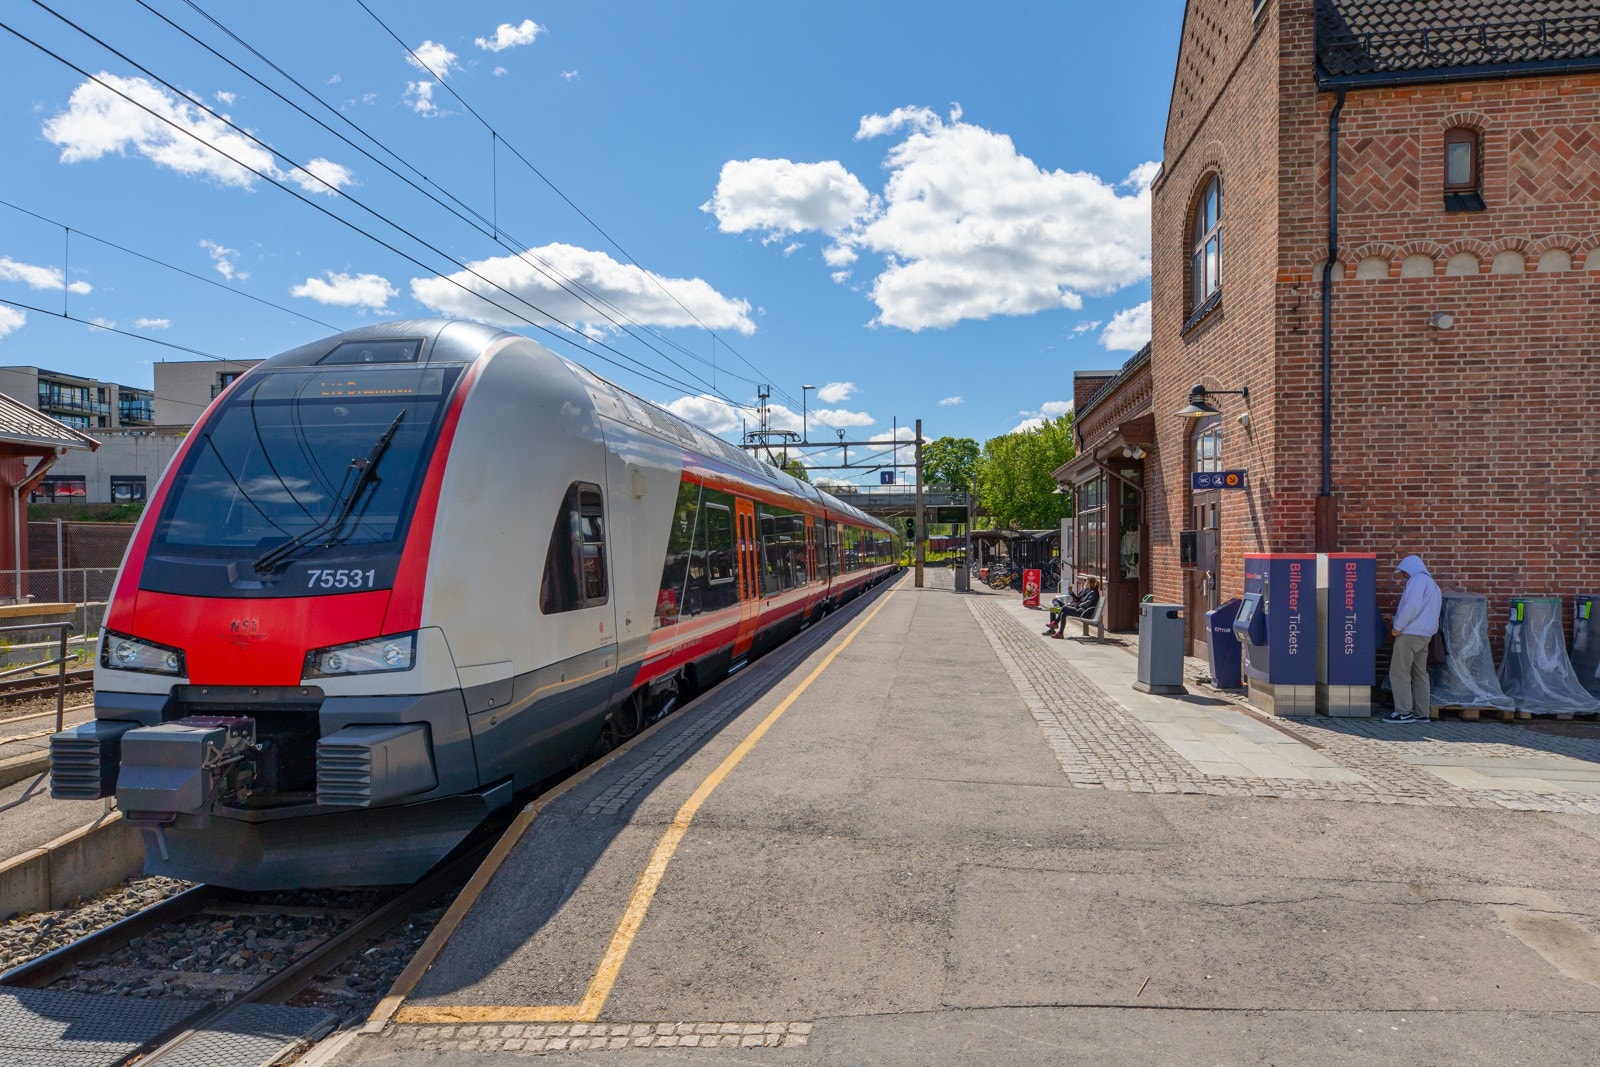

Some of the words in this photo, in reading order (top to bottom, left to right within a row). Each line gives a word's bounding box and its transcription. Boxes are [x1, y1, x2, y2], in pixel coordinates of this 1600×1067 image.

[307, 569, 375, 588] 75531
[1289, 563, 1301, 611] Billetter
[1345, 562, 1357, 611] Billetter
[1289, 614, 1301, 655] Tickets
[1345, 613, 1357, 655] Tickets
